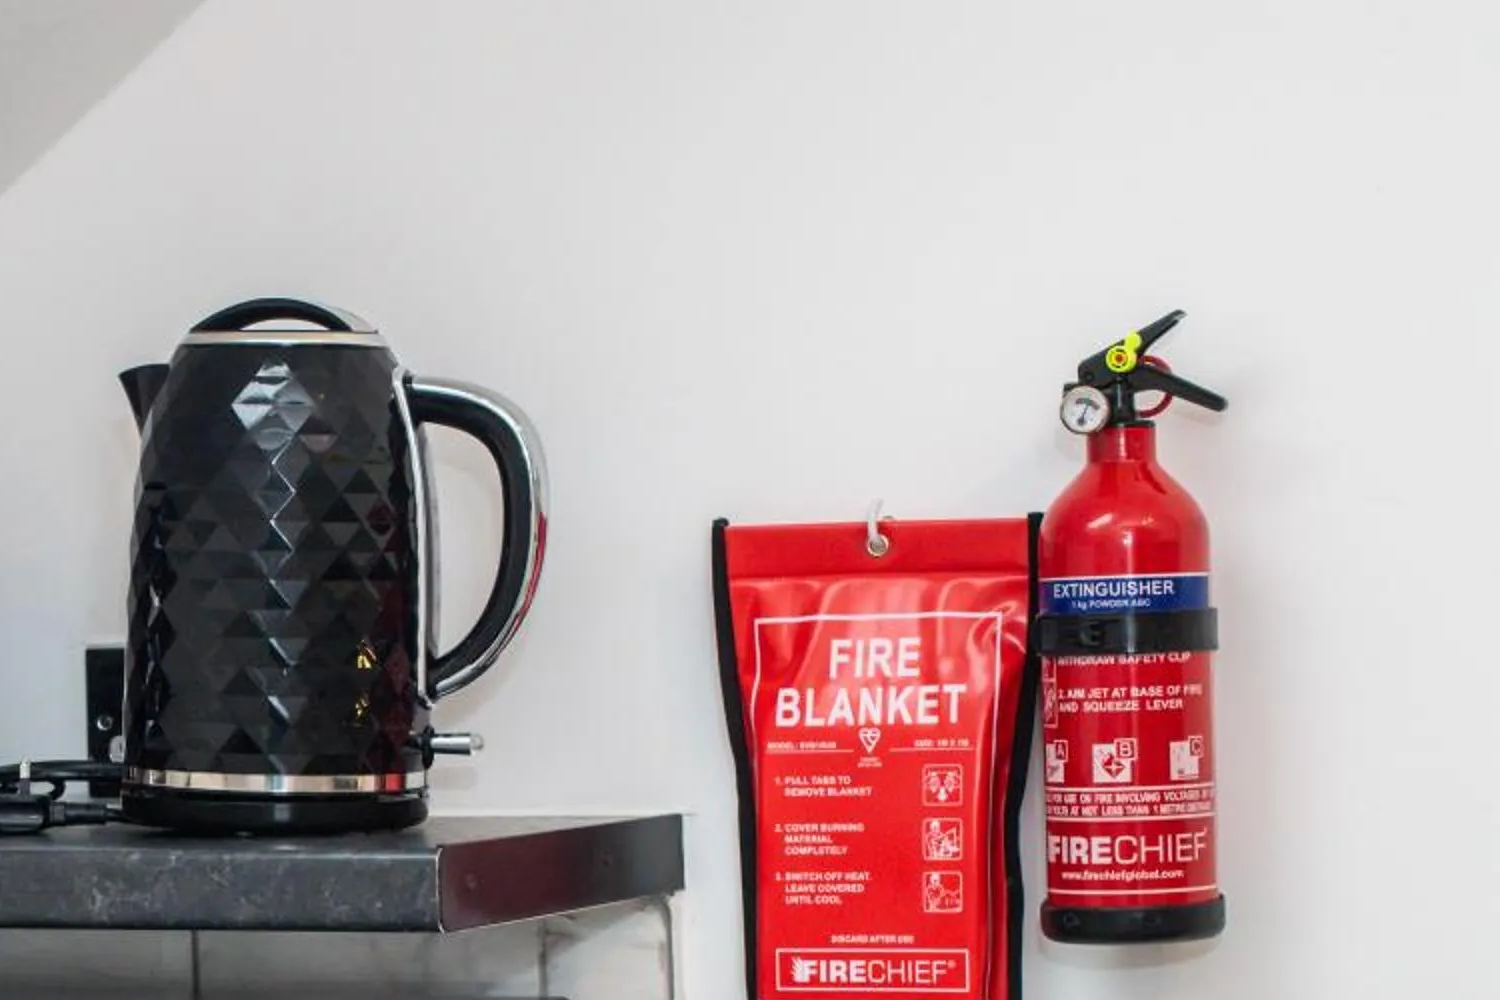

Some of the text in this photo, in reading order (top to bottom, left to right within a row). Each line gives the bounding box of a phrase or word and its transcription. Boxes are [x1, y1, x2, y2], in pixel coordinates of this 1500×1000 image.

[1053, 580, 1175, 599] EXTINGUISHER
[829, 637, 921, 680] FIRE
[1118, 653, 1165, 665] SAFETY
[1168, 652, 1191, 664] CLIP
[1088, 688, 1109, 699] JET
[1111, 687, 1127, 698] AT
[1130, 686, 1164, 698] BASE
[1166, 685, 1181, 697] OF
[775, 684, 967, 728] BLANKET
[1083, 700, 1139, 712] SQUEEZE
[1145, 699, 1184, 711] LEVER
[784, 776, 810, 785] PULL
[838, 776, 852, 785] TO
[784, 786, 873, 797] REMOVE BLANKET
[784, 823, 819, 833] COVER
[820, 823, 865, 833] BURNING
[784, 834, 833, 844] MATERIAL
[784, 845, 848, 856] COMPLETELY
[785, 871, 823, 881] SWITCH
[824, 871, 842, 881] OFF
[785, 883, 865, 893] LEAVE COVERED
[785, 895, 813, 905] UNTIL
